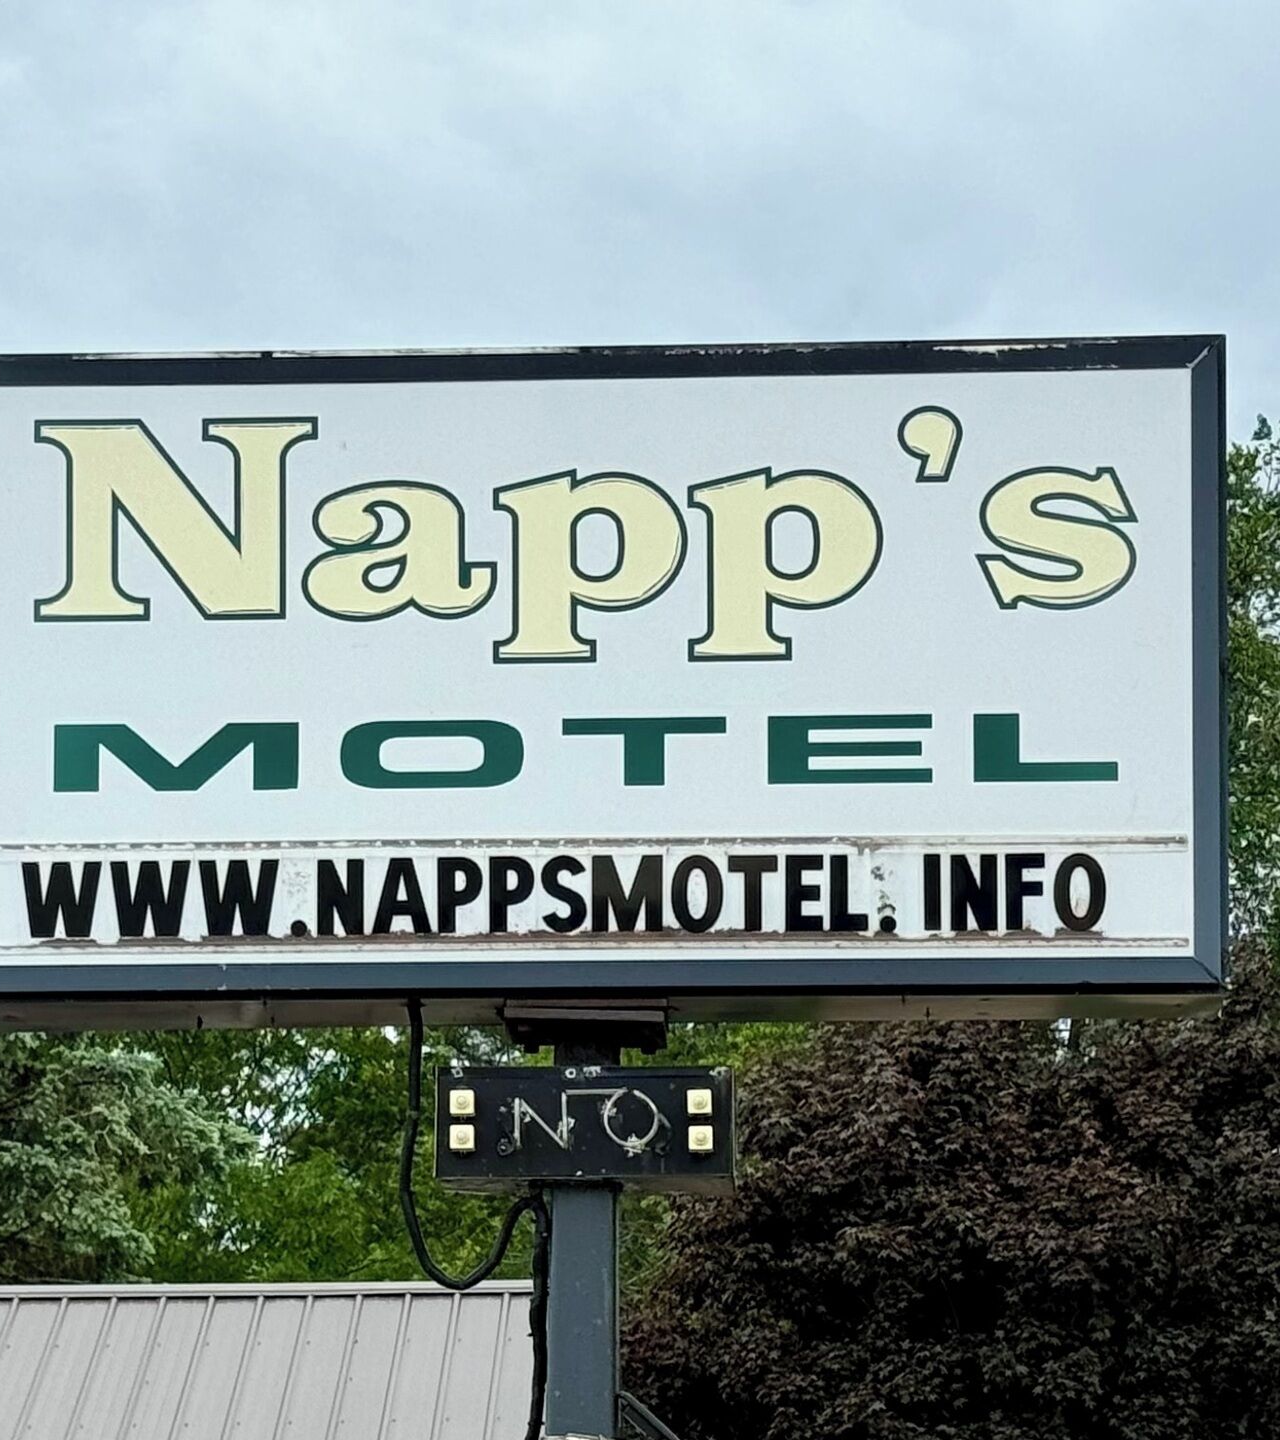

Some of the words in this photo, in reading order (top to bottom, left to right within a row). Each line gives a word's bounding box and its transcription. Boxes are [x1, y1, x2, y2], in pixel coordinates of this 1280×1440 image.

[33, 406, 1138, 663] Napp's
[53, 713, 1119, 792] MOTEL
[21, 852, 1107, 938] WWW.NAPPSMOTEL.INFO
